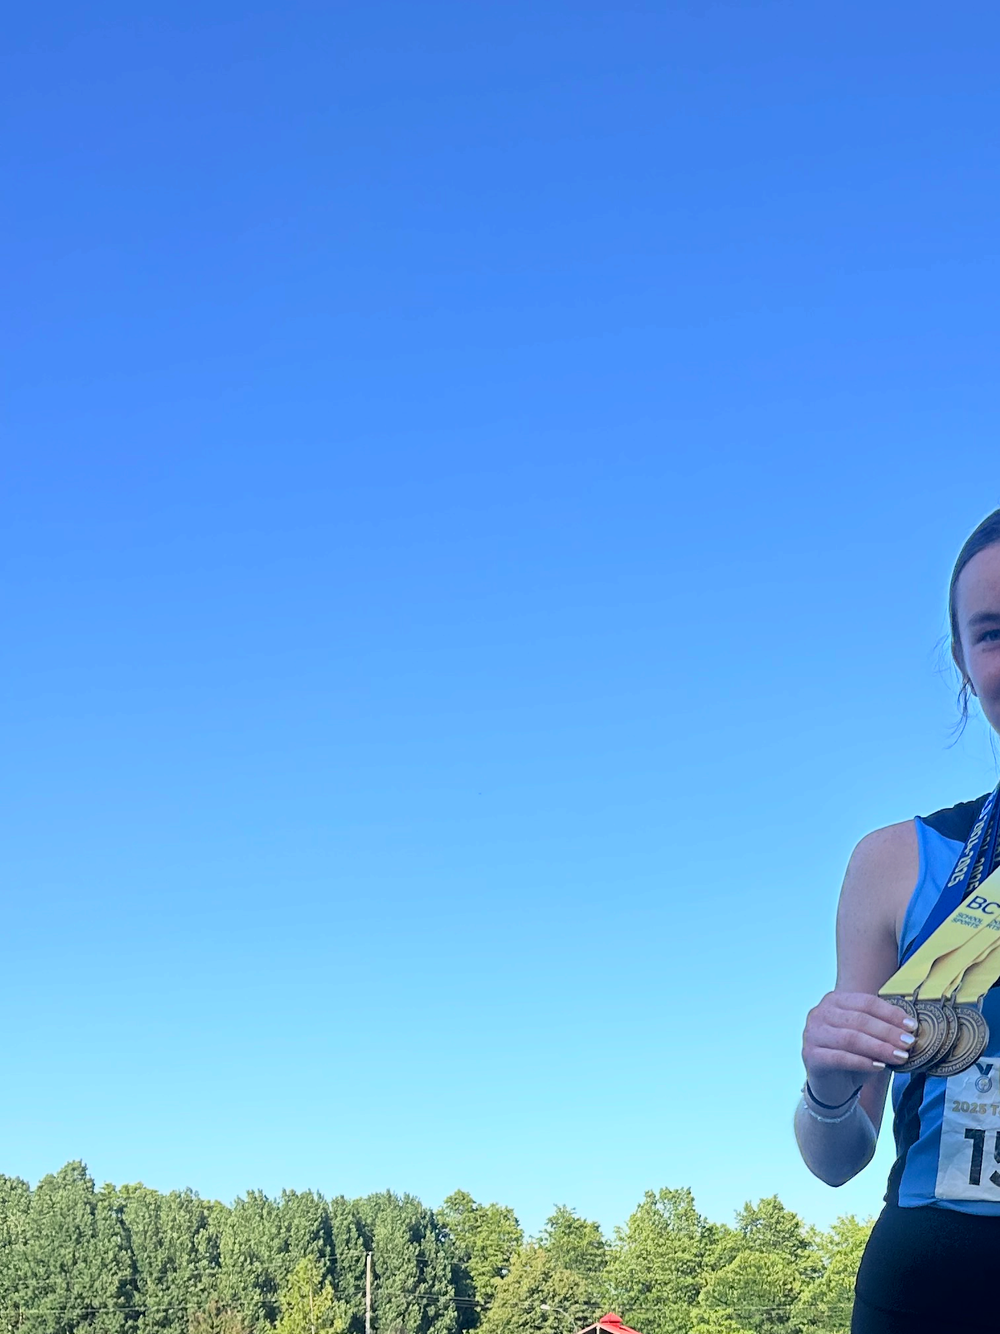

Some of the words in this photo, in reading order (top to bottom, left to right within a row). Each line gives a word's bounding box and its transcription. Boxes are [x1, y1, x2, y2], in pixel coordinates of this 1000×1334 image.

[966, 895, 1000, 915] BC
[951, 917, 980, 929] SPORTS
[957, 912, 983, 924] SCHOOL
[952, 1100, 987, 1114] 2025
